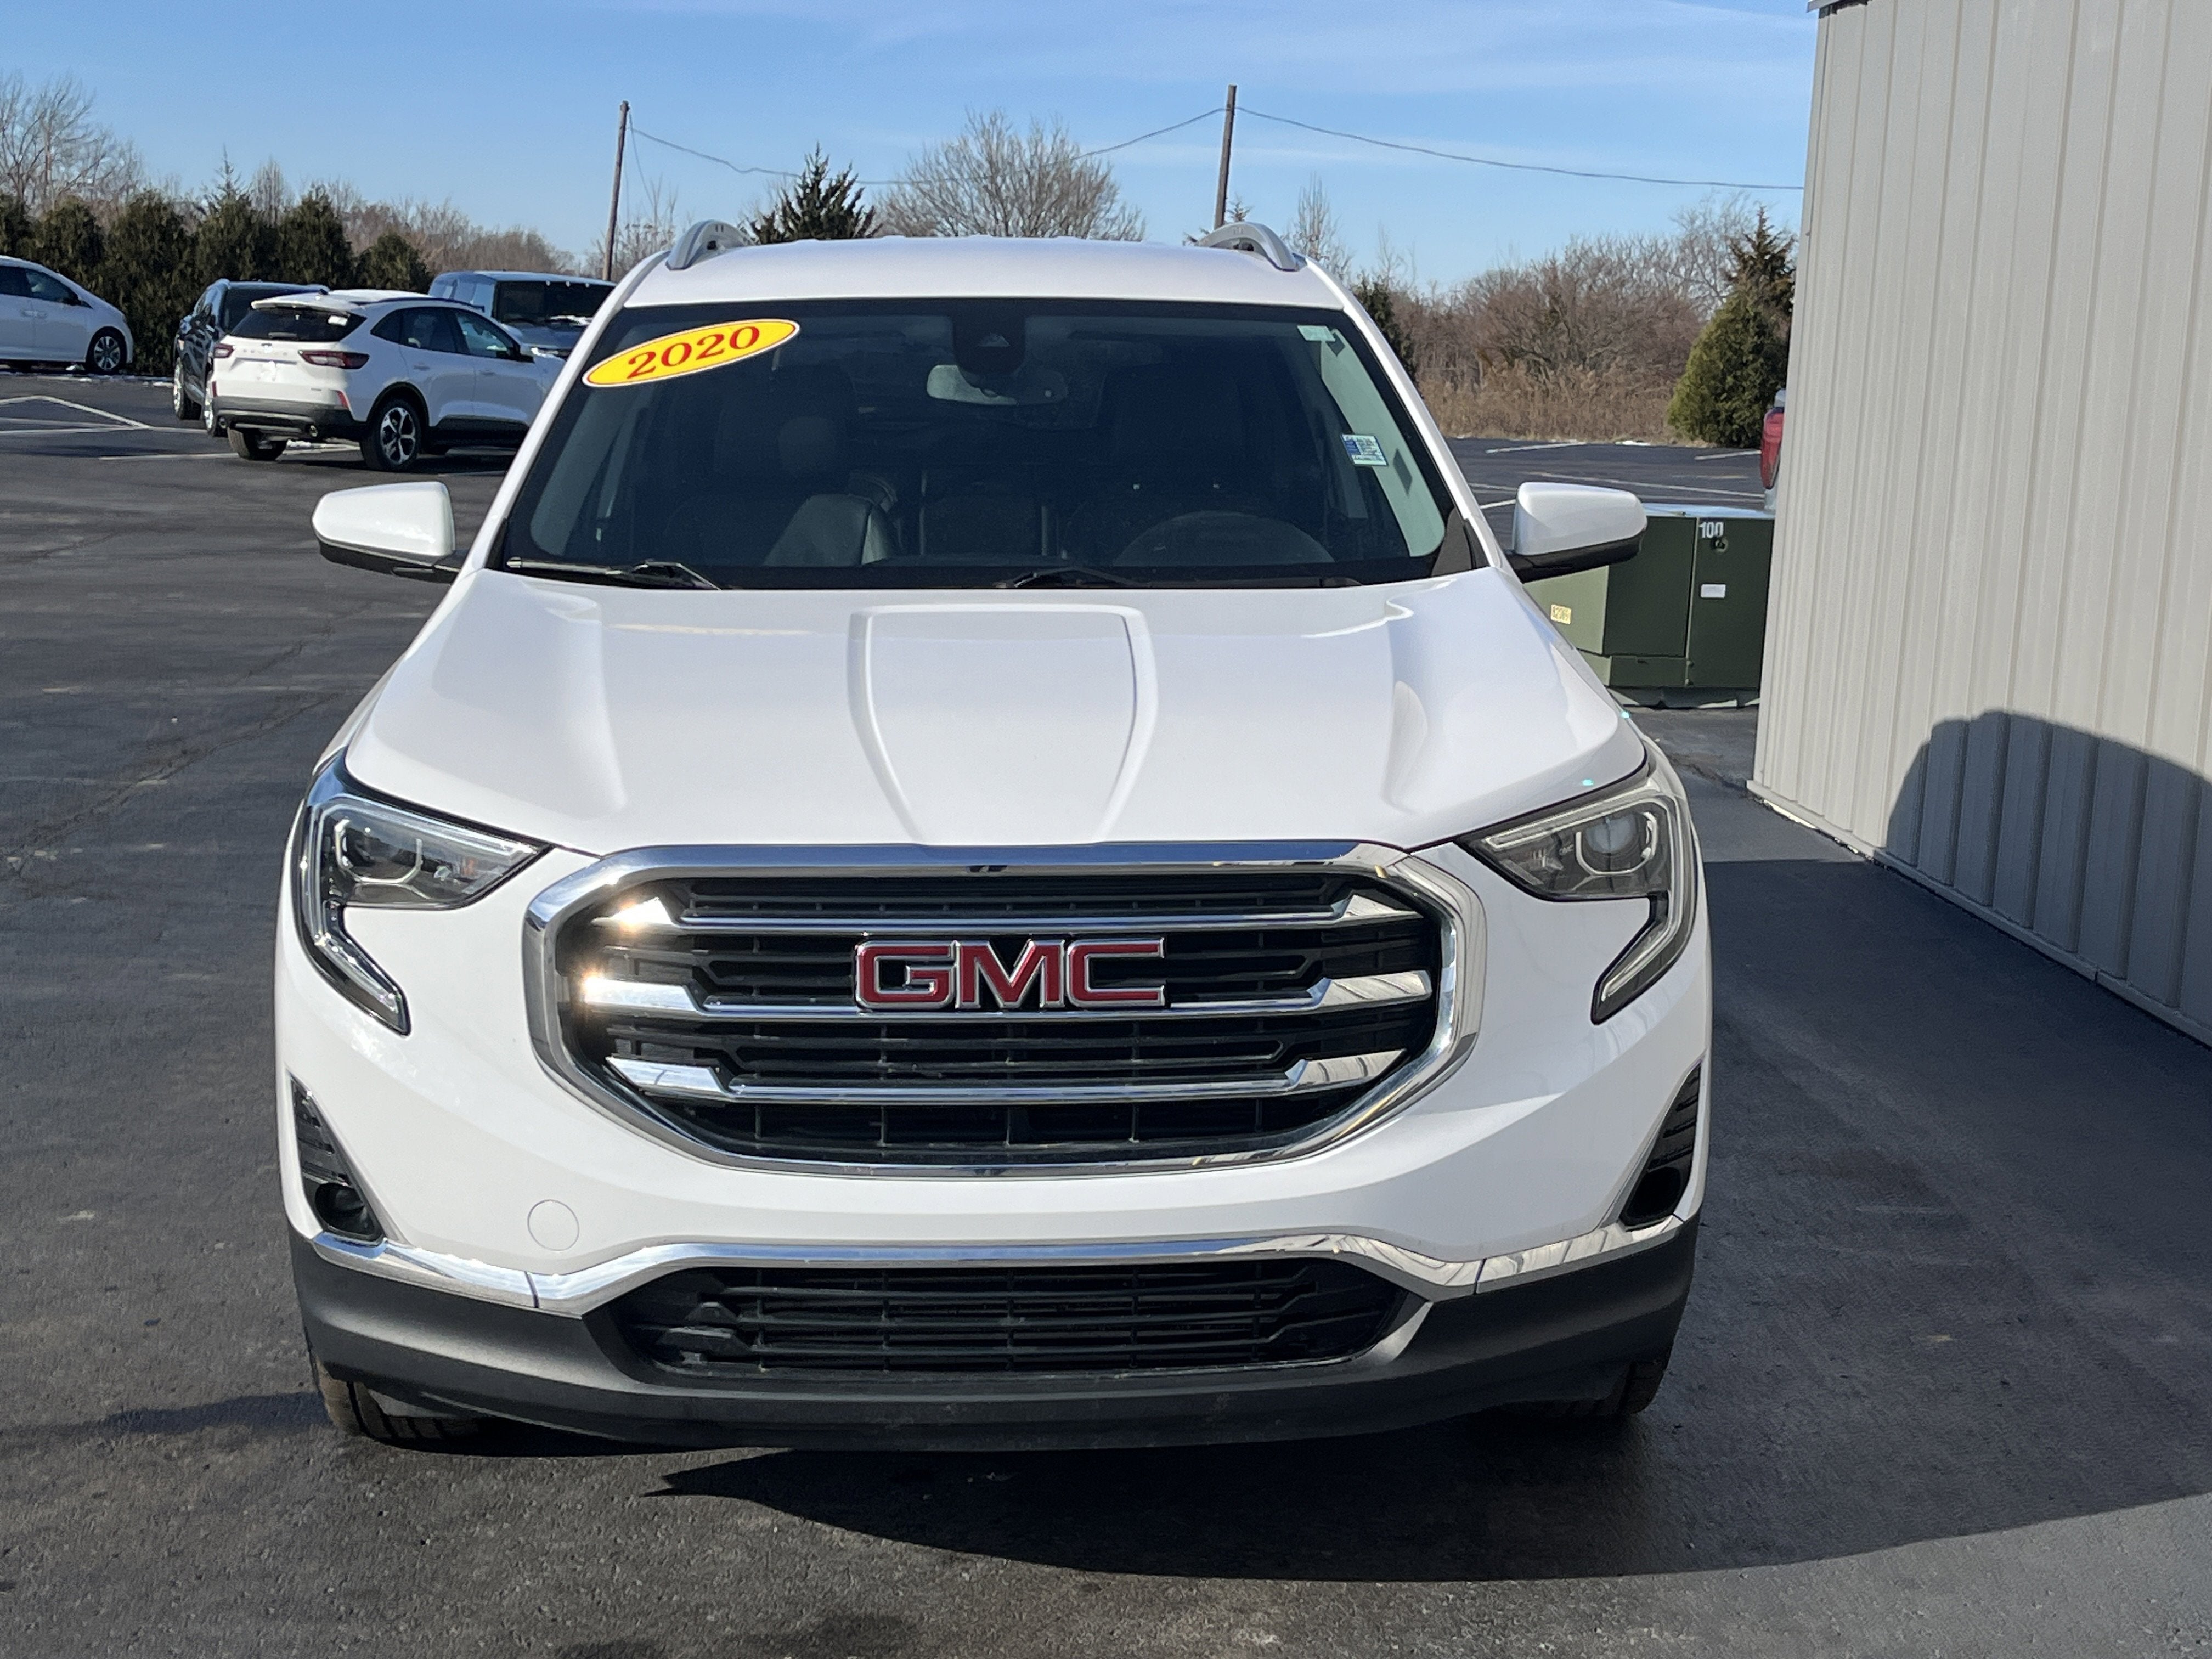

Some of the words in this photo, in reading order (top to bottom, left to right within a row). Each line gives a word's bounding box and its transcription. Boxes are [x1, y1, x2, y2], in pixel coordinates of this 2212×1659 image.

[627, 326, 760, 379] 2020
[1699, 521, 1723, 538] 100
[856, 938, 1165, 1008] GMC
